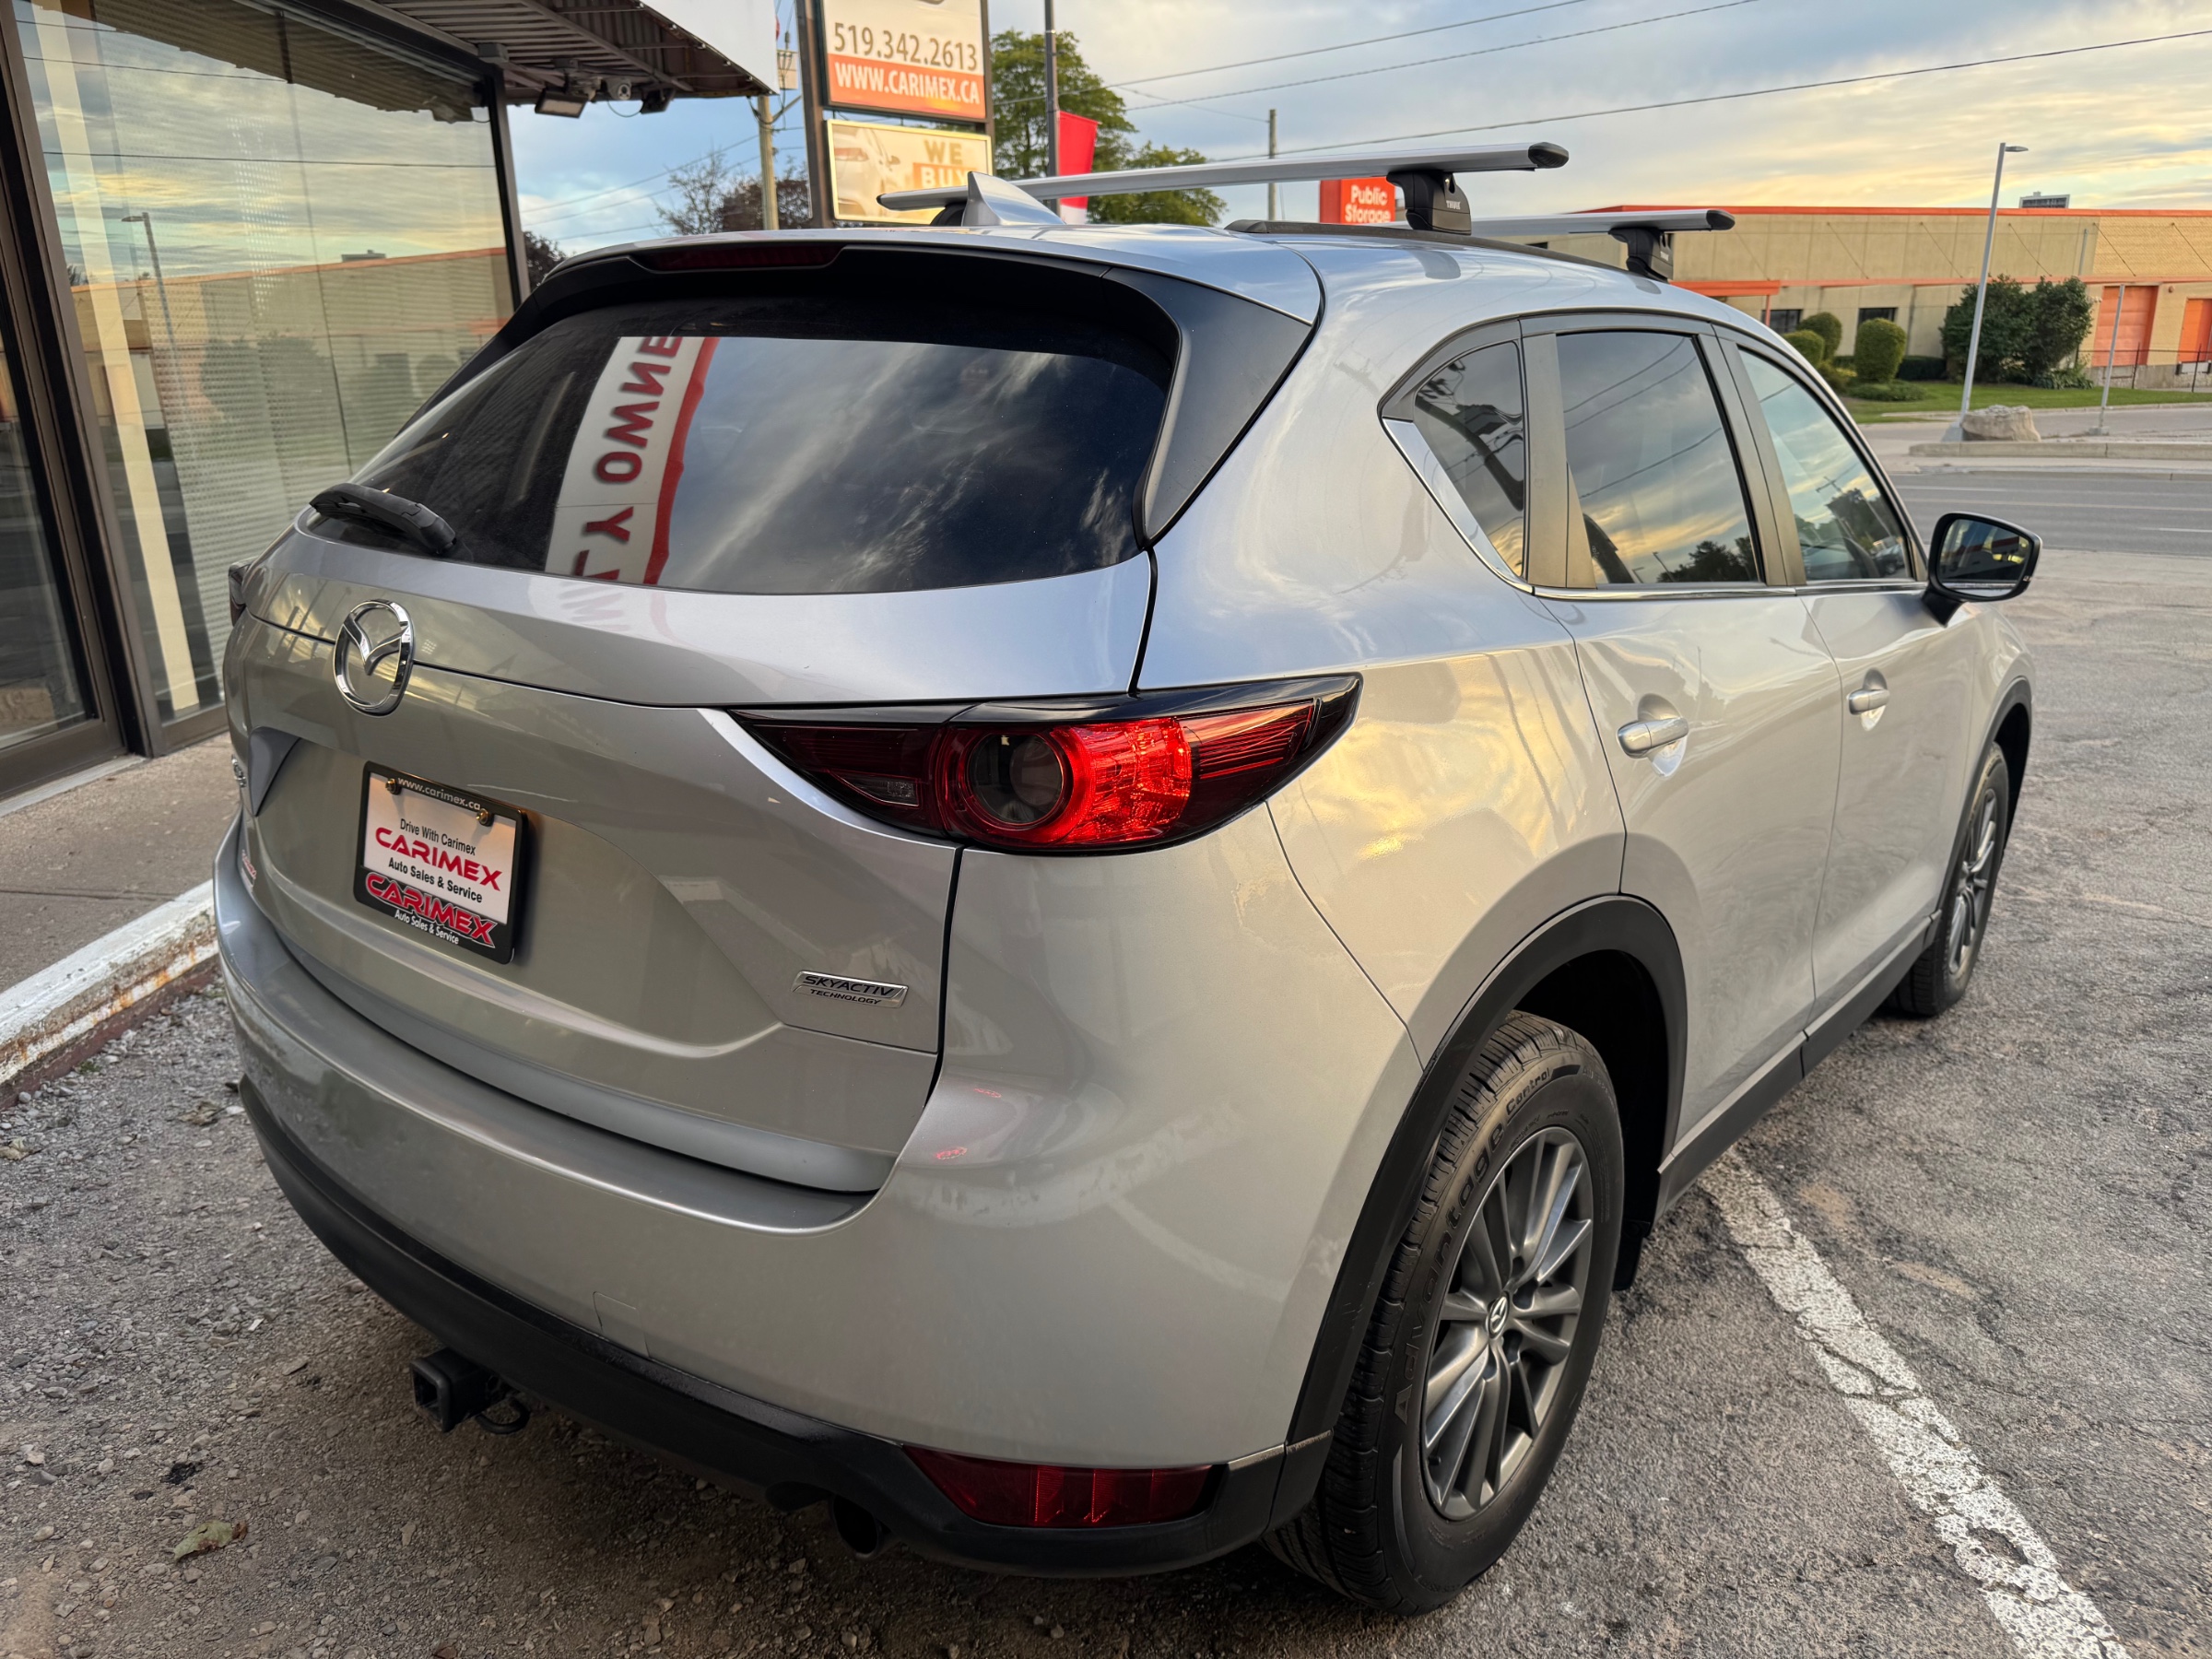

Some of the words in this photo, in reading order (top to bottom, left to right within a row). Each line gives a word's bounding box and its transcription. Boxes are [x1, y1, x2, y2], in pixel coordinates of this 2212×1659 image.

[833, 22, 978, 72] 519.342.2613
[834, 62, 980, 105] WWW.CARIMEX.CA
[924, 139, 963, 164] WE
[1345, 204, 1392, 223] Storage
[1350, 184, 1388, 206] Public
[397, 776, 481, 810] www.carimex.ca
[400, 818, 420, 836] Drive
[421, 825, 440, 843] With
[441, 832, 477, 856] Carimex
[375, 827, 502, 892] CARIMEX
[388, 856, 408, 876] Auto
[410, 865, 435, 885] Sales
[437, 876, 445, 888] &
[447, 879, 483, 903] Service
[366, 872, 497, 947] CARIMEX
[394, 909, 411, 924] Auto
[411, 915, 429, 933] Sales
[429, 924, 435, 935] &
[436, 926, 459, 946] Service
[803, 975, 895, 996] SKYACTIV
[810, 988, 882, 1005] TECHNOLOGY
[1506, 1067, 1550, 1116] Control
